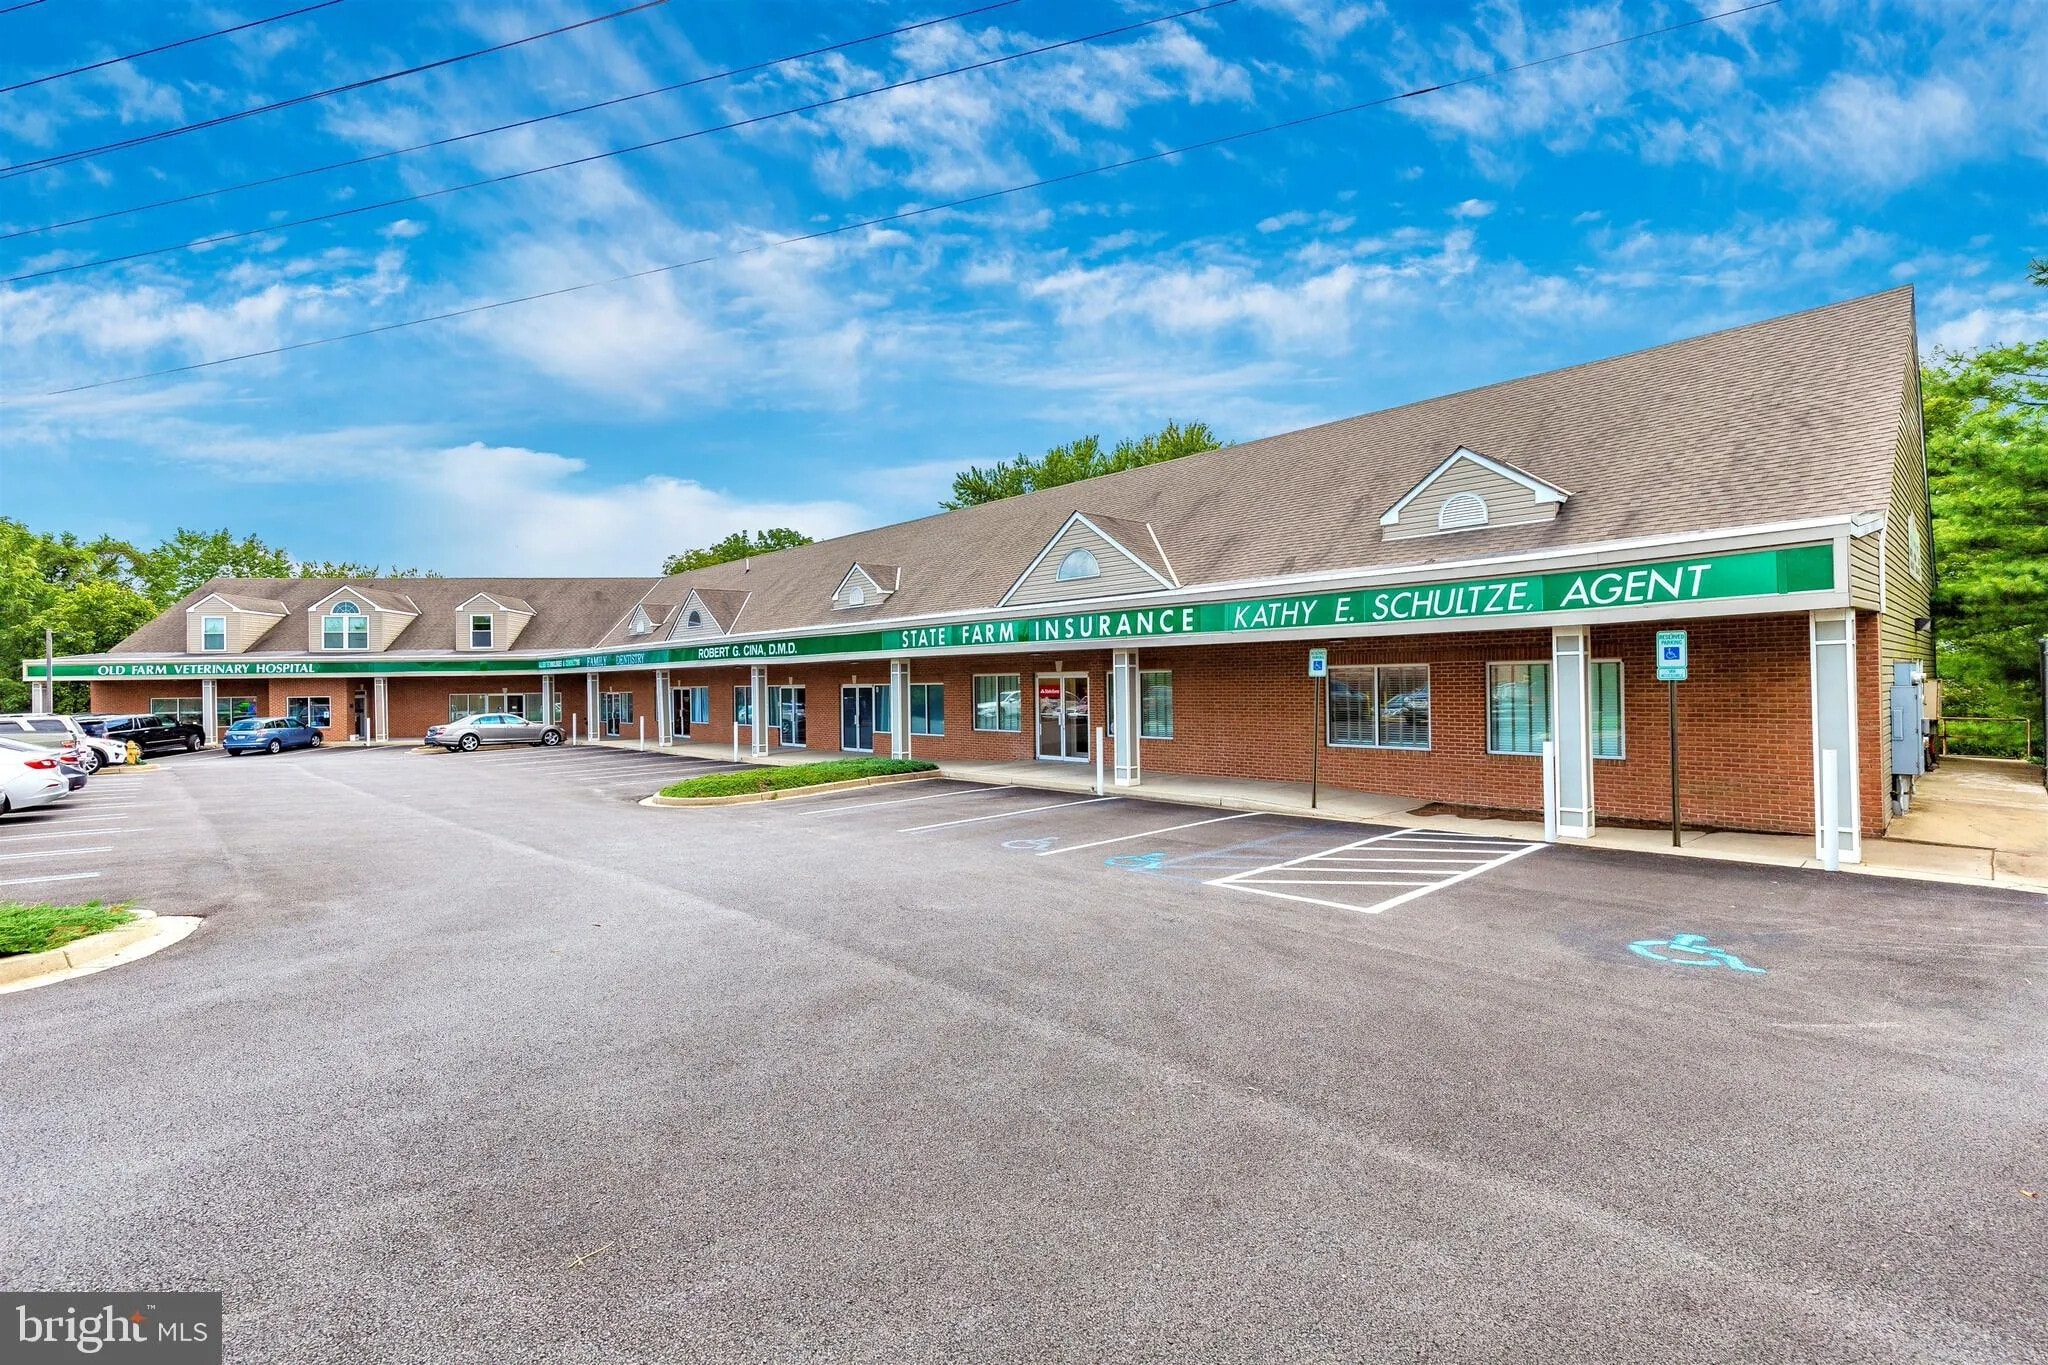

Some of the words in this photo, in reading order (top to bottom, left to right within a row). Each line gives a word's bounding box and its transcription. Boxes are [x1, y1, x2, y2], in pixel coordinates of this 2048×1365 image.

[1234, 600, 1318, 629] KATHY
[1334, 597, 1355, 623] E.
[1372, 581, 1534, 620] SCHULTZE,
[1560, 564, 1712, 608] AGENT
[902, 627, 945, 648] STATE
[962, 622, 1014, 644] FARM
[1035, 608, 1194, 641] INSURANCE
[698, 646, 729, 659] ROBERT
[732, 647, 741, 657] G.
[743, 644, 766, 656] CINA,
[768, 642, 797, 655] D.M.D.
[586, 655, 608, 667] FAMILY
[615, 653, 645, 665] DENTISTRY
[97, 665, 126, 676] OLD
[131, 665, 167, 675] FARM
[174, 664, 250, 675] VETERINARY
[256, 663, 315, 674] HOSPITAL
